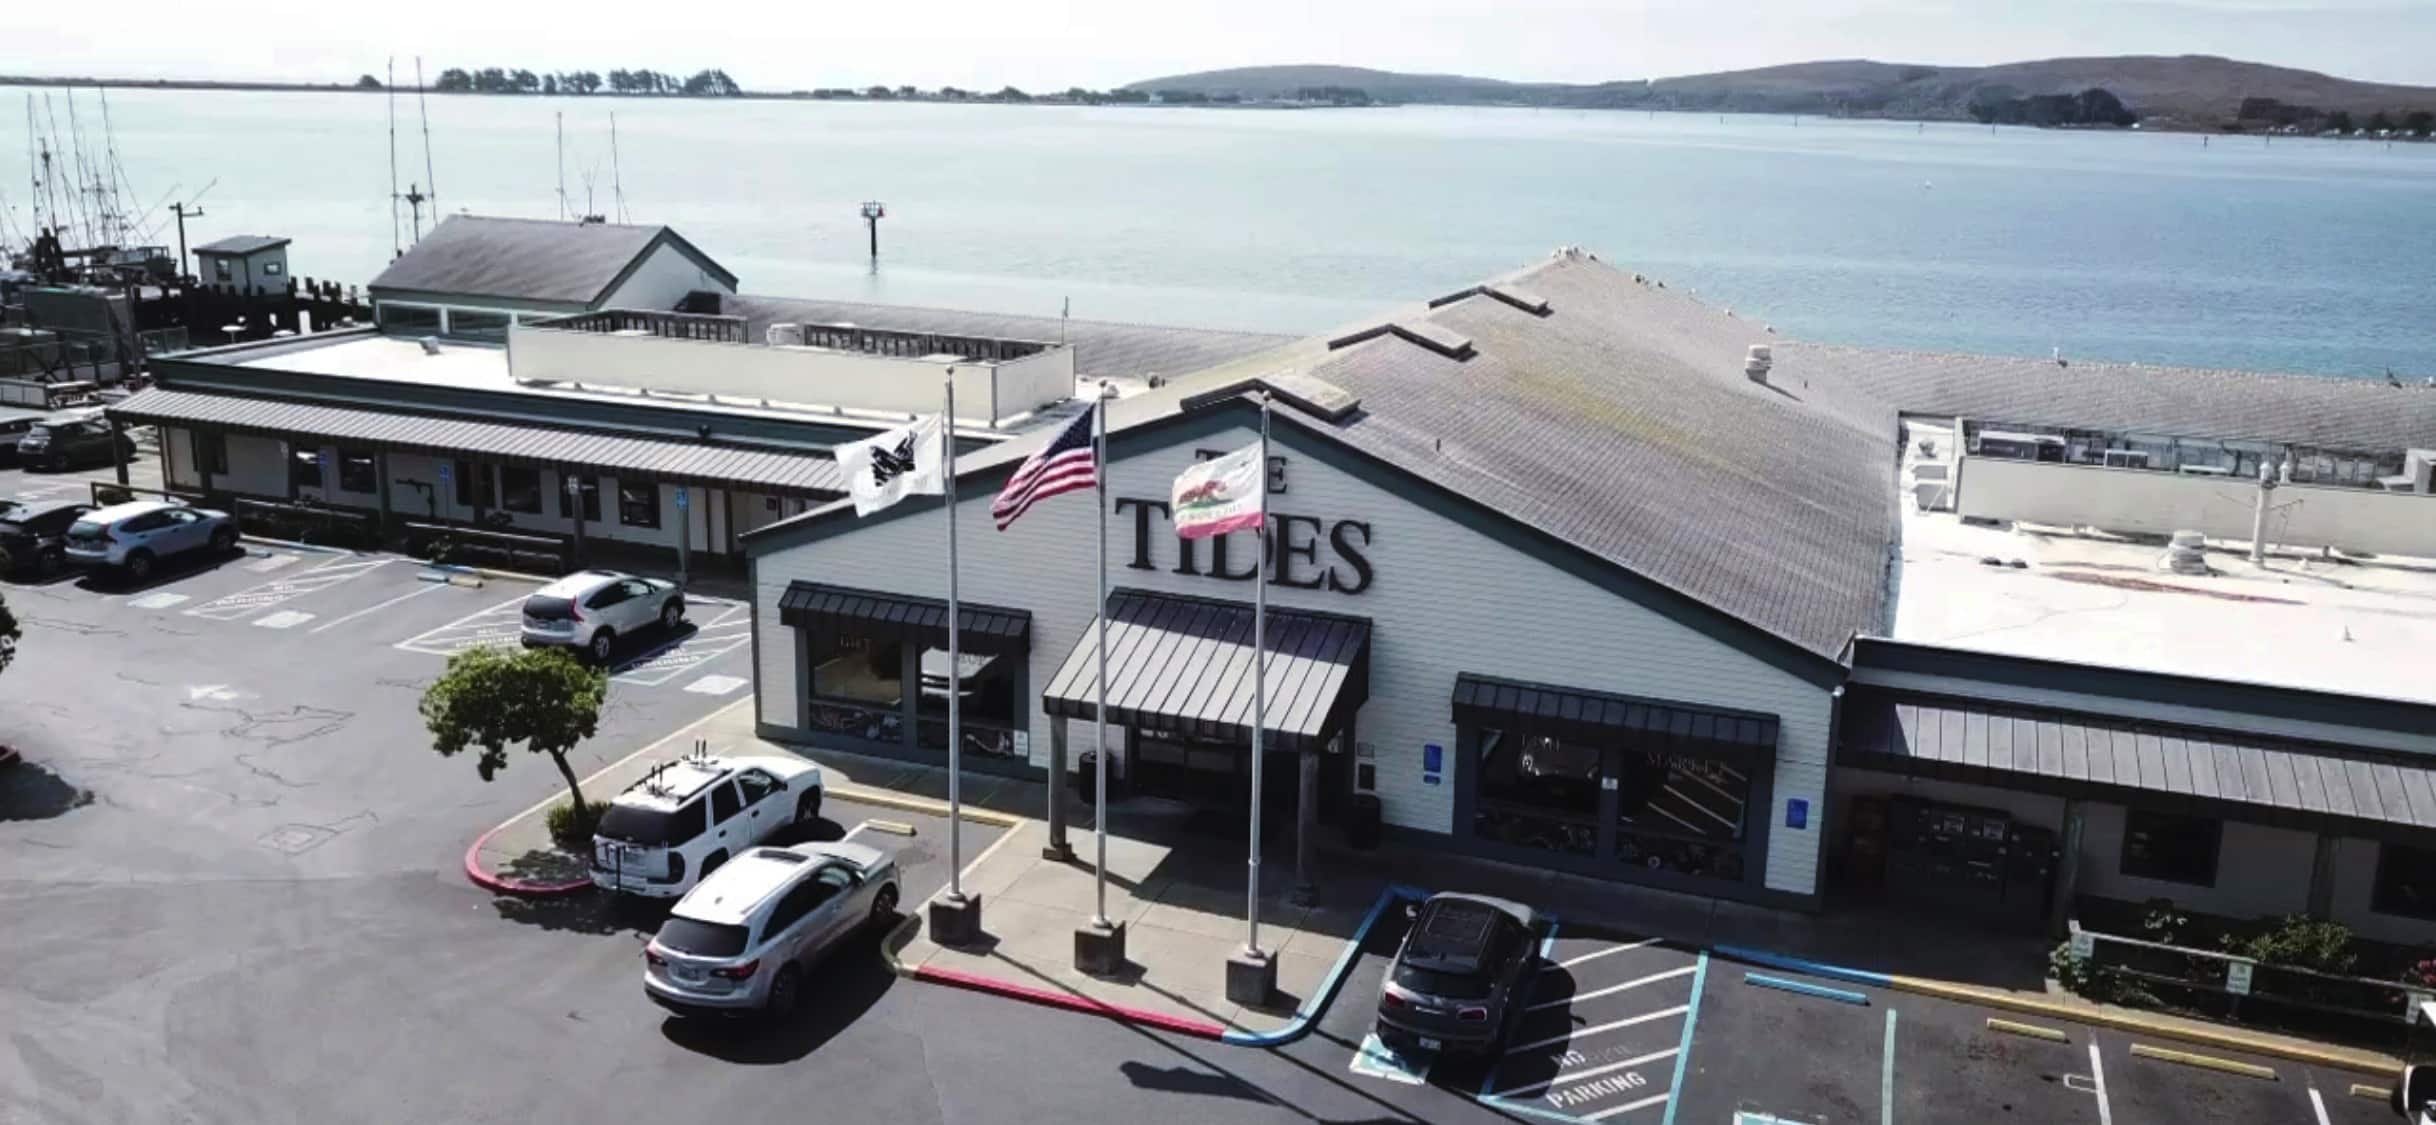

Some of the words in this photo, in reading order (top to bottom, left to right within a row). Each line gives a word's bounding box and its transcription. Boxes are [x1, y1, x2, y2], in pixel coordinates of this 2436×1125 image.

[1115, 497, 1373, 595] TIDES
[1549, 1050, 1586, 1069] NO
[1545, 1072, 1647, 1109] PARKING
